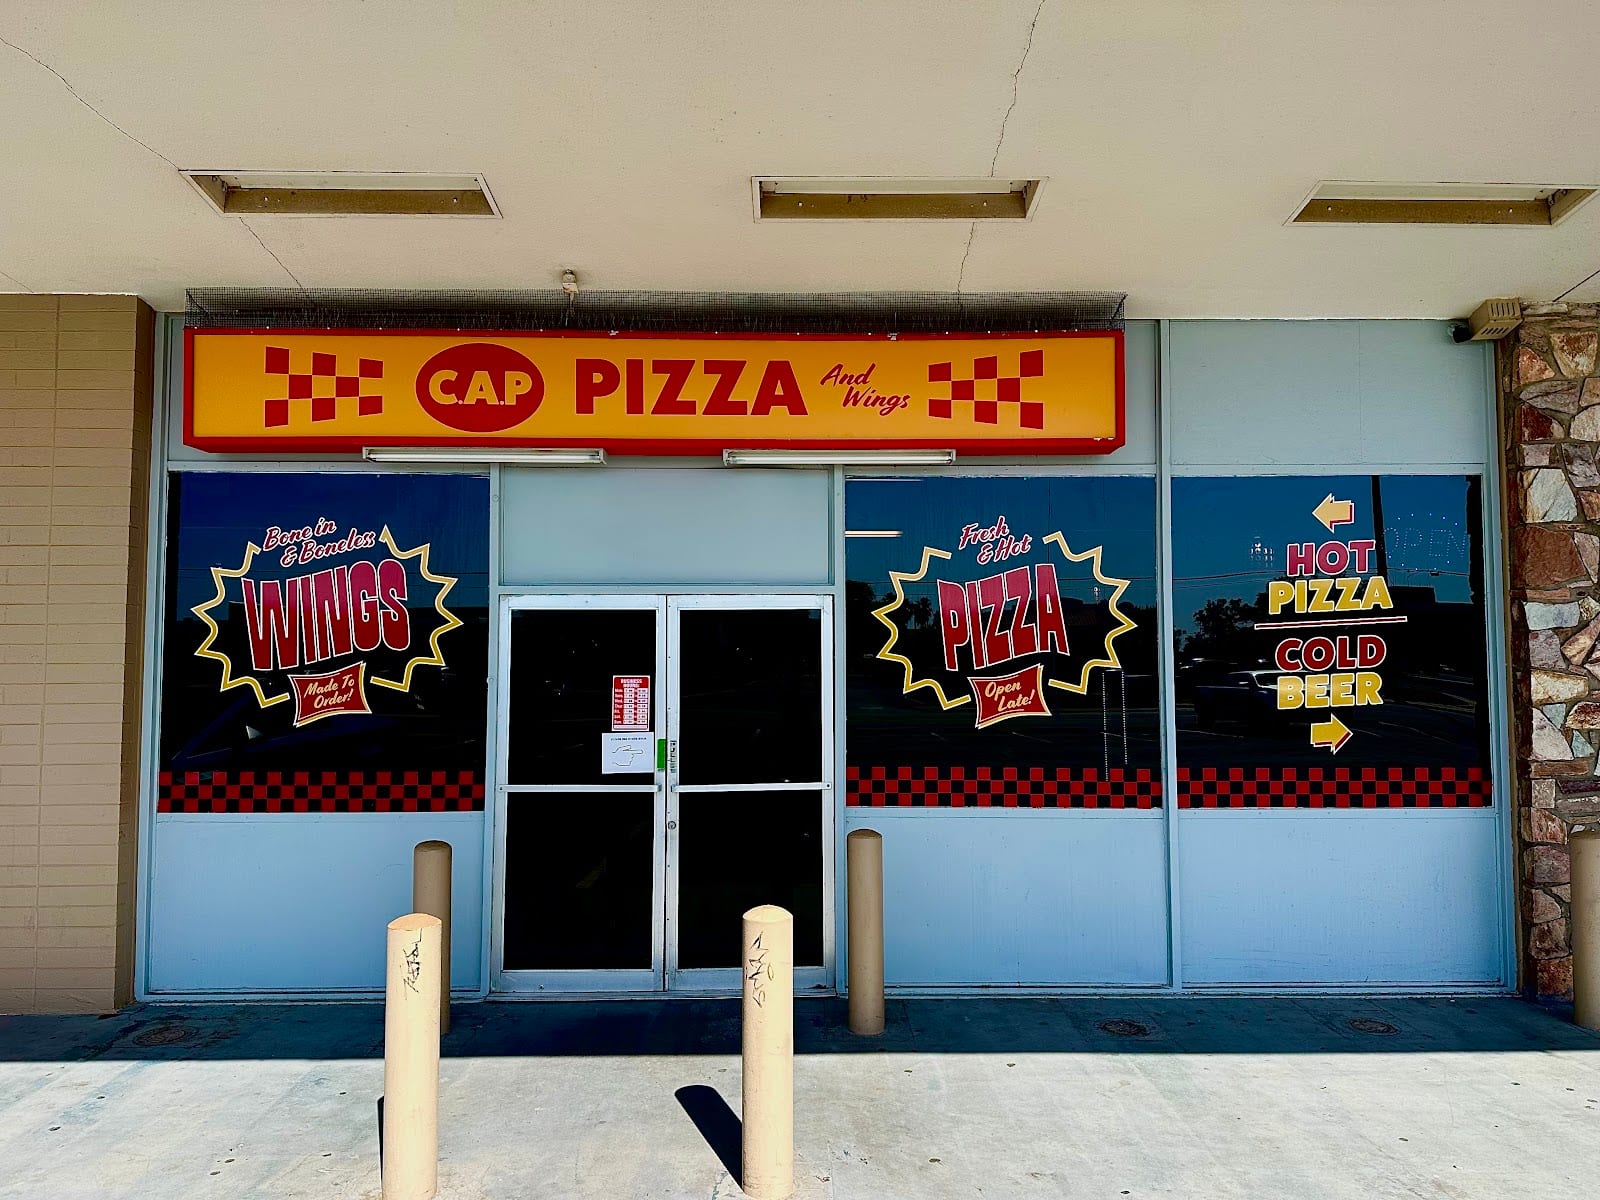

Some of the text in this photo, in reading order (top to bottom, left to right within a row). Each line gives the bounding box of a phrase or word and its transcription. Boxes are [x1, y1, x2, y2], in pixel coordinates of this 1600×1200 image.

[575, 358, 808, 416] PIZZA
[819, 363, 871, 387] And
[841, 386, 911, 416] Wings
[263, 517, 337, 551] Bone in
[280, 528, 376, 567] & Boneless
[958, 515, 1010, 550] Fresh
[976, 534, 1033, 564] & Hot
[1286, 540, 1376, 577] HOT
[1268, 576, 1393, 615] PIZZA
[241, 558, 411, 671] WINGS
[937, 563, 1070, 671] PIZZA
[1275, 634, 1387, 672] COLD
[303, 674, 355, 698] Made To
[313, 688, 355, 709] Order!
[984, 681, 1022, 701] Open
[997, 689, 1035, 712] Late!
[1276, 672, 1383, 710] BEER
